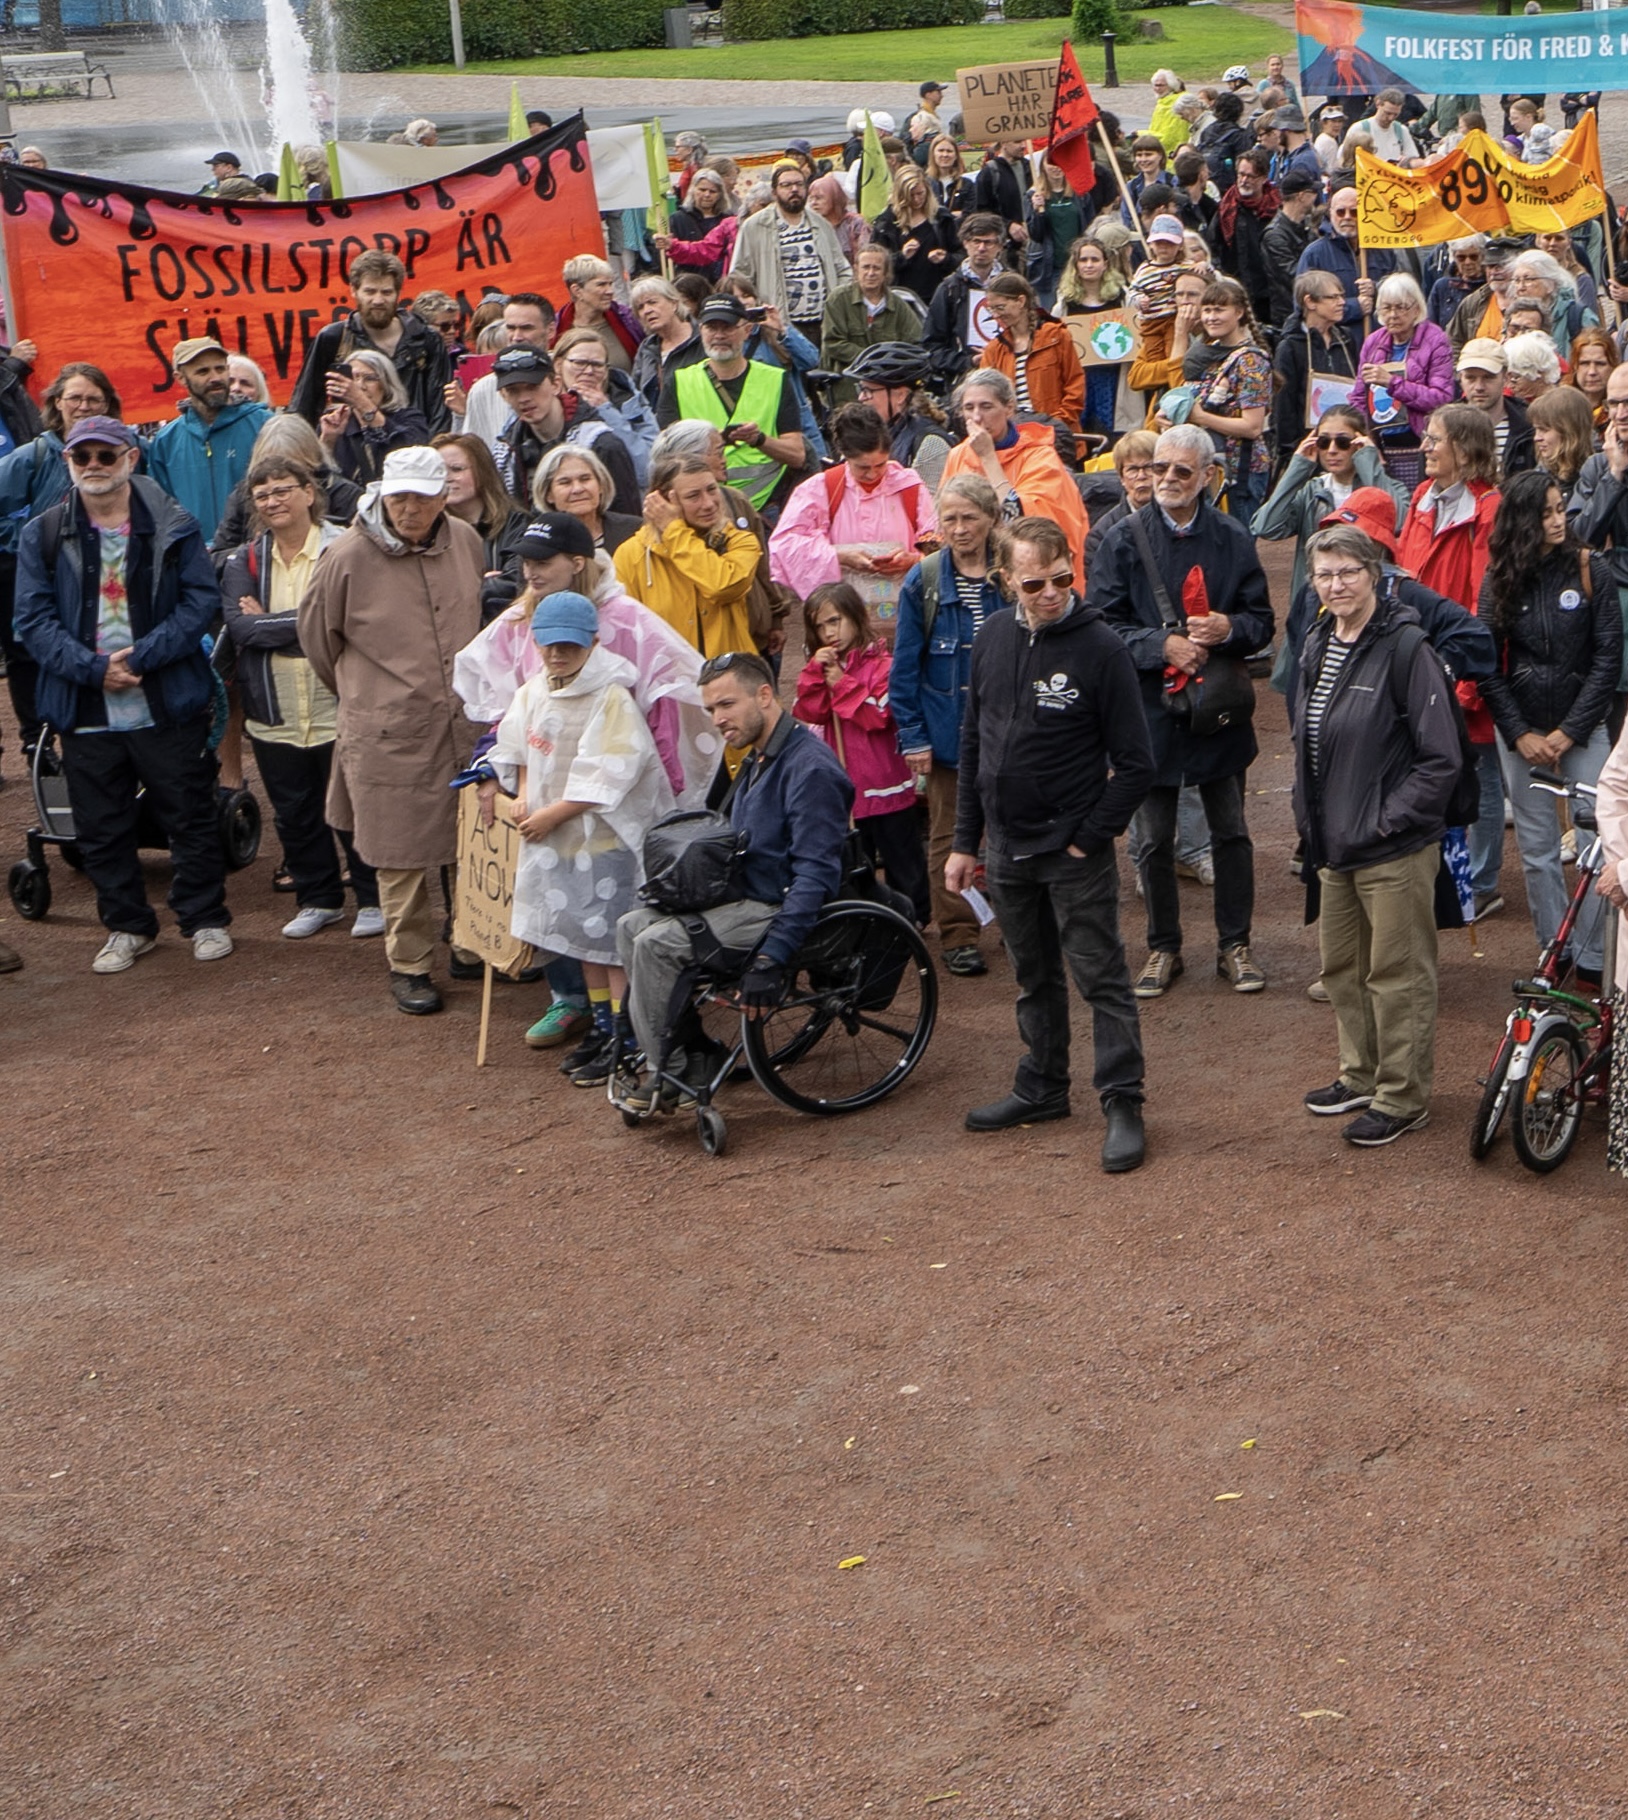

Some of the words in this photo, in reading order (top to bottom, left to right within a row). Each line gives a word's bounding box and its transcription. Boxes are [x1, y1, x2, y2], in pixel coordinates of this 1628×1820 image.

[1385, 37, 1484, 61] FOLKFEST
[1491, 33, 1533, 61] FÖR
[1540, 36, 1591, 59] FRED
[1599, 34, 1614, 57] &
[964, 66, 1059, 99] PLANETE
[1007, 92, 1043, 112] HAR
[985, 111, 1055, 134] GRÄNSE
[456, 210, 512, 271] ÄR
[471, 807, 518, 863] ACT
